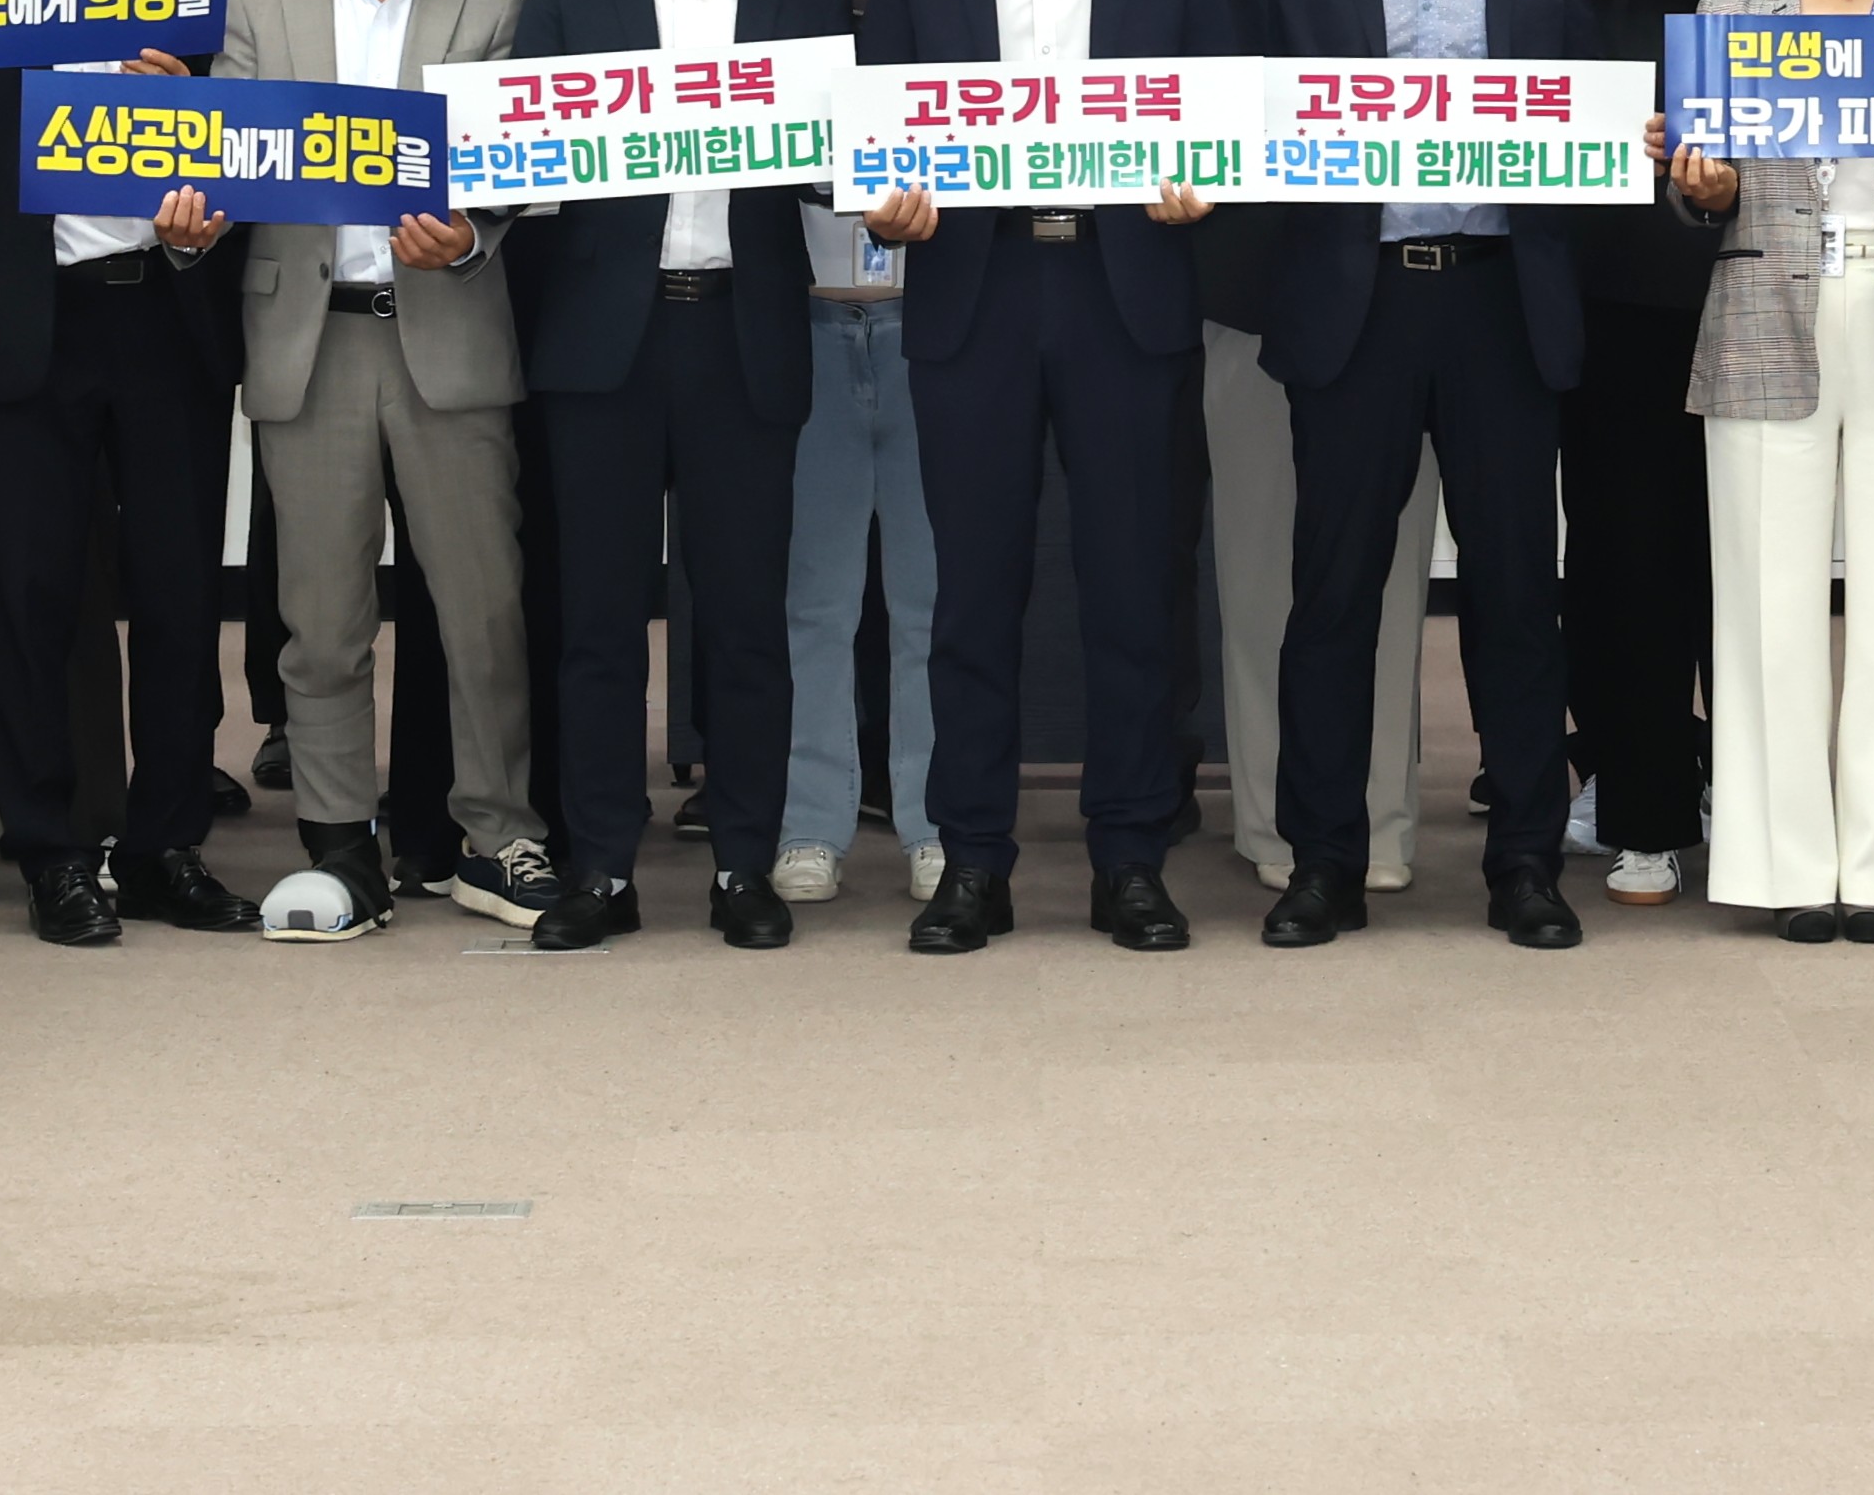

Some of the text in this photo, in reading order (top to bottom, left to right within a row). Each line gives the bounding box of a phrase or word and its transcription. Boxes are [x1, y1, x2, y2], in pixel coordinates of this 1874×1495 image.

[1728, 32, 1862, 81] 민생에
[500, 58, 774, 122] 고유가 극복
[905, 75, 1181, 126] 고유가 극복
[1297, 75, 1571, 122] 고유가 극복
[37, 106, 430, 187] 소상공인에게 희망을
[1681, 97, 1823, 146] 고유가
[450, 121, 834, 191] 부안군이 함께합니다!
[853, 140, 1241, 195] 부안군이 함께합니다!
[1417, 140, 1628, 187] 함께합니다!
